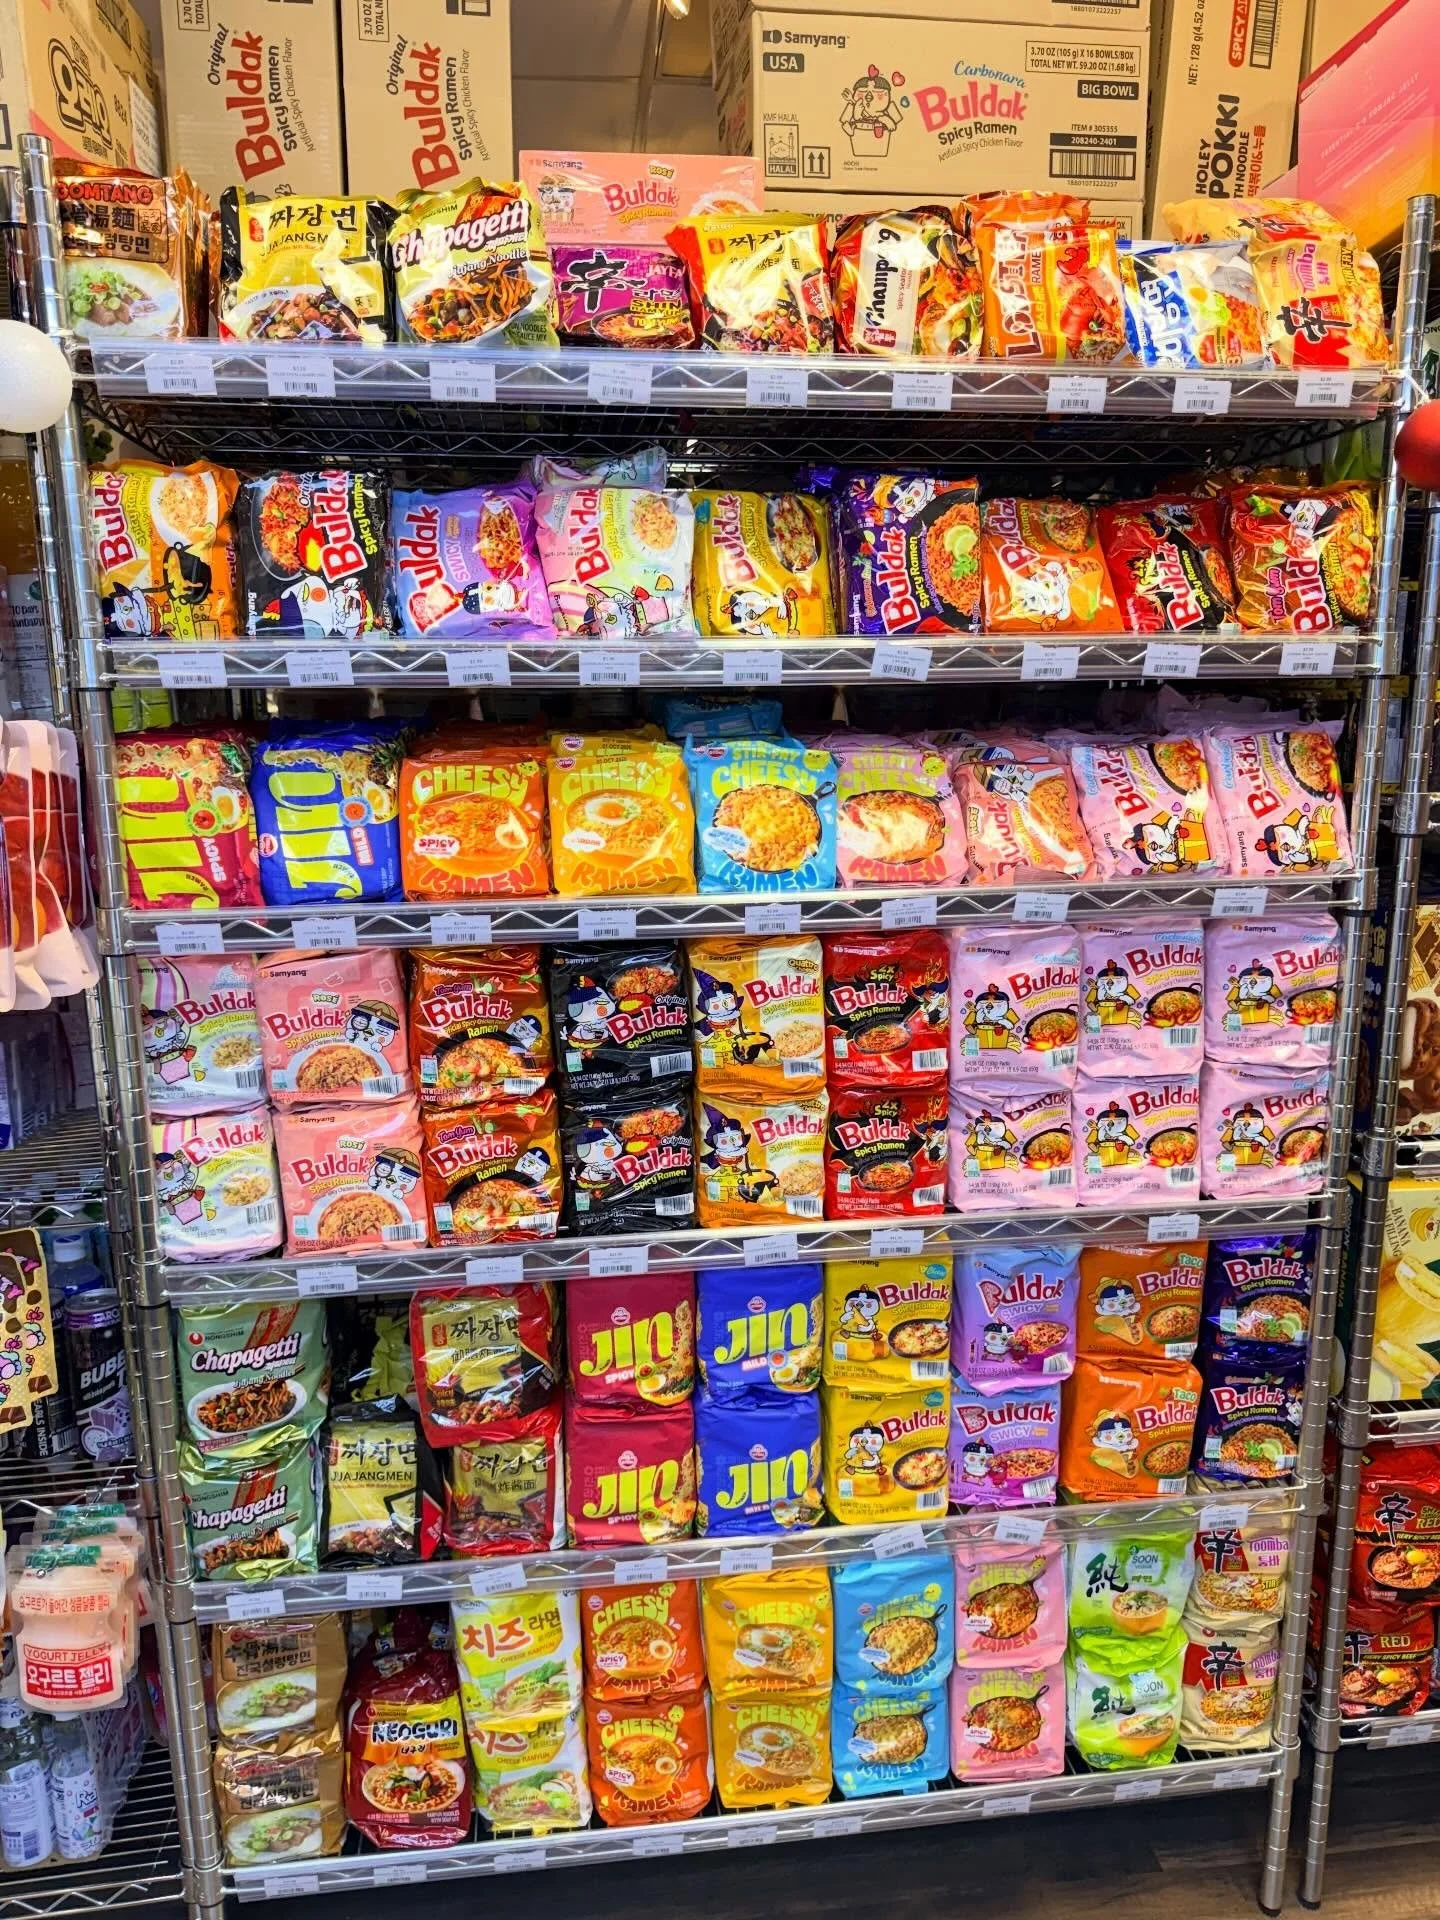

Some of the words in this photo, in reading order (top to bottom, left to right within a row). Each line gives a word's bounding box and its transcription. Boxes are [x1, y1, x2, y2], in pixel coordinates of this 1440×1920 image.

[207, 23, 229, 86] Original
[784, 31, 846, 48] Samyang
[1031, 47, 1045, 57] 3.70
[1046, 48, 1055, 57] OZ
[1056, 48, 1071, 58] (105
[1086, 50, 1094, 58] 16
[1095, 50, 1134, 60] BOWLS/BOX
[1231, 18, 1247, 60] SPICY
[268, 45, 283, 104] Ramen
[386, 34, 408, 95] Original
[769, 56, 799, 70] USA
[954, 60, 1026, 89] Carbonara
[1031, 59, 1050, 68] TOTAL
[1051, 61, 1065, 69] NET
[1079, 61, 1097, 70] 59.20
[1098, 62, 1107, 71] OZ
[445, 56, 461, 115] Ramen
[1081, 84, 1101, 95] BIG
[1103, 85, 1135, 97] BOWL
[226, 31, 286, 182] Buldak
[404, 41, 461, 189] Buldak
[779, 113, 799, 122] HALAL
[912, 80, 1028, 133] Buldak
[277, 103, 299, 151] Spicy
[452, 115, 473, 161] Spicy
[938, 125, 972, 146] Spicy
[973, 121, 1017, 137] Ramen
[1071, 137, 1117, 146] 208240-2401
[1072, 124, 1087, 132] ITEM
[768, 165, 795, 174] HALAL
[1236, 131, 1250, 182] NOODLE
[602, 181, 679, 214] Buldak
[560, 249, 648, 314] 辛
[1296, 242, 1317, 292] Toomba
[1276, 297, 1352, 342] 辛
[359, 518, 379, 556] Spicy
[444, 538, 471, 583] SWICY
[909, 536, 919, 577] Ramen
[876, 526, 922, 635] Buldak
[917, 577, 931, 609] Spicy
[1155, 542, 1204, 632] Buldak
[412, 764, 528, 807] CHEESY
[561, 760, 674, 804] CHEESY
[712, 760, 817, 800] CHEESY
[418, 838, 456, 850] SPICY
[202, 837, 227, 884] SPICY
[570, 857, 680, 893] RAMEN
[848, 855, 948, 882] RAMEN
[418, 861, 538, 895] RAMEN
[715, 860, 820, 894] RAMEN
[1245, 925, 1277, 934] Samyang
[565, 956, 599, 965] Samyang
[709, 954, 742, 962] Samyang
[976, 947, 1011, 956] Samyang
[1125, 946, 1202, 979] Buldak
[1272, 946, 1342, 979] Buldak
[269, 968, 308, 977] Samyang
[870, 970, 895, 982] Spicy
[1008, 966, 1079, 1001] Buldak
[654, 994, 688, 1006] Original
[745, 974, 820, 1008] Buldak
[831, 983, 909, 1016] Buldak
[175, 991, 256, 1025] Buldak
[265, 1008, 346, 1039] Buldak
[421, 993, 512, 1029] Buldak
[849, 1008, 872, 1022] Spicy
[872, 1004, 901, 1016] Ramen
[285, 1034, 309, 1049] Spicy
[309, 1030, 340, 1042] Ramen
[468, 1024, 499, 1039] Ramen
[607, 1005, 688, 1045] Buldak
[627, 1033, 651, 1050] Spicy
[651, 1027, 683, 1040] Ramen
[1127, 1085, 1200, 1119] Buldak
[181, 1124, 266, 1168] Buldak
[752, 1115, 824, 1147] Buldak
[837, 1119, 911, 1151] Buldak
[428, 1135, 519, 1179] Buldak
[854, 1144, 877, 1158] Spicy
[877, 1141, 905, 1152] Ramen
[291, 1153, 369, 1185] Buldak
[476, 1164, 508, 1182] Ramen
[613, 1146, 693, 1187] Buldak
[634, 1175, 657, 1192] Spicy
[657, 1167, 687, 1181] Ramen
[1391, 1206, 1411, 1247] BANANA
[1178, 1254, 1203, 1268] Taco
[1225, 1256, 1304, 1288] Buldak
[877, 1282, 950, 1308] Buldak
[978, 1273, 1065, 1317] Buldak
[1239, 1279, 1262, 1291] Spicy
[1262, 1276, 1295, 1288] Ramen
[1000, 1302, 1043, 1320] SWICY
[191, 1332, 301, 1376] Chapagetti
[604, 1371, 635, 1385] SPICY
[1172, 1387, 1197, 1402] Taco
[1210, 1385, 1286, 1414] Buldak
[881, 1410, 947, 1444] Buldak
[954, 1401, 1057, 1435] Buldak
[1227, 1410, 1249, 1422] Spicy
[1249, 1405, 1278, 1417] Ramen
[990, 1425, 1030, 1444] SWICY
[1373, 1492, 1417, 1547] 辛
[1131, 1553, 1159, 1566] SOON
[592, 1594, 670, 1633] CHEESY
[735, 1601, 817, 1630] CHEESY
[462, 1616, 532, 1659] 치즈
[527, 1607, 562, 1631] 라면
[971, 1627, 1038, 1653] RAMEN
[1381, 1635, 1411, 1648] RED
[26, 1648, 68, 1661] YOGURT
[1202, 1641, 1245, 1691] 辛
[27, 1664, 78, 1689] 요구르트
[79, 1660, 111, 1689] 젤리
[602, 1668, 679, 1693] RAMEN
[372, 1718, 459, 1745] NEOGURI
[601, 1718, 679, 1751] CHEESY
[736, 1702, 818, 1737] CHEESY
[608, 1769, 632, 1781] SPICY
[614, 1781, 684, 1813] RAMEN
